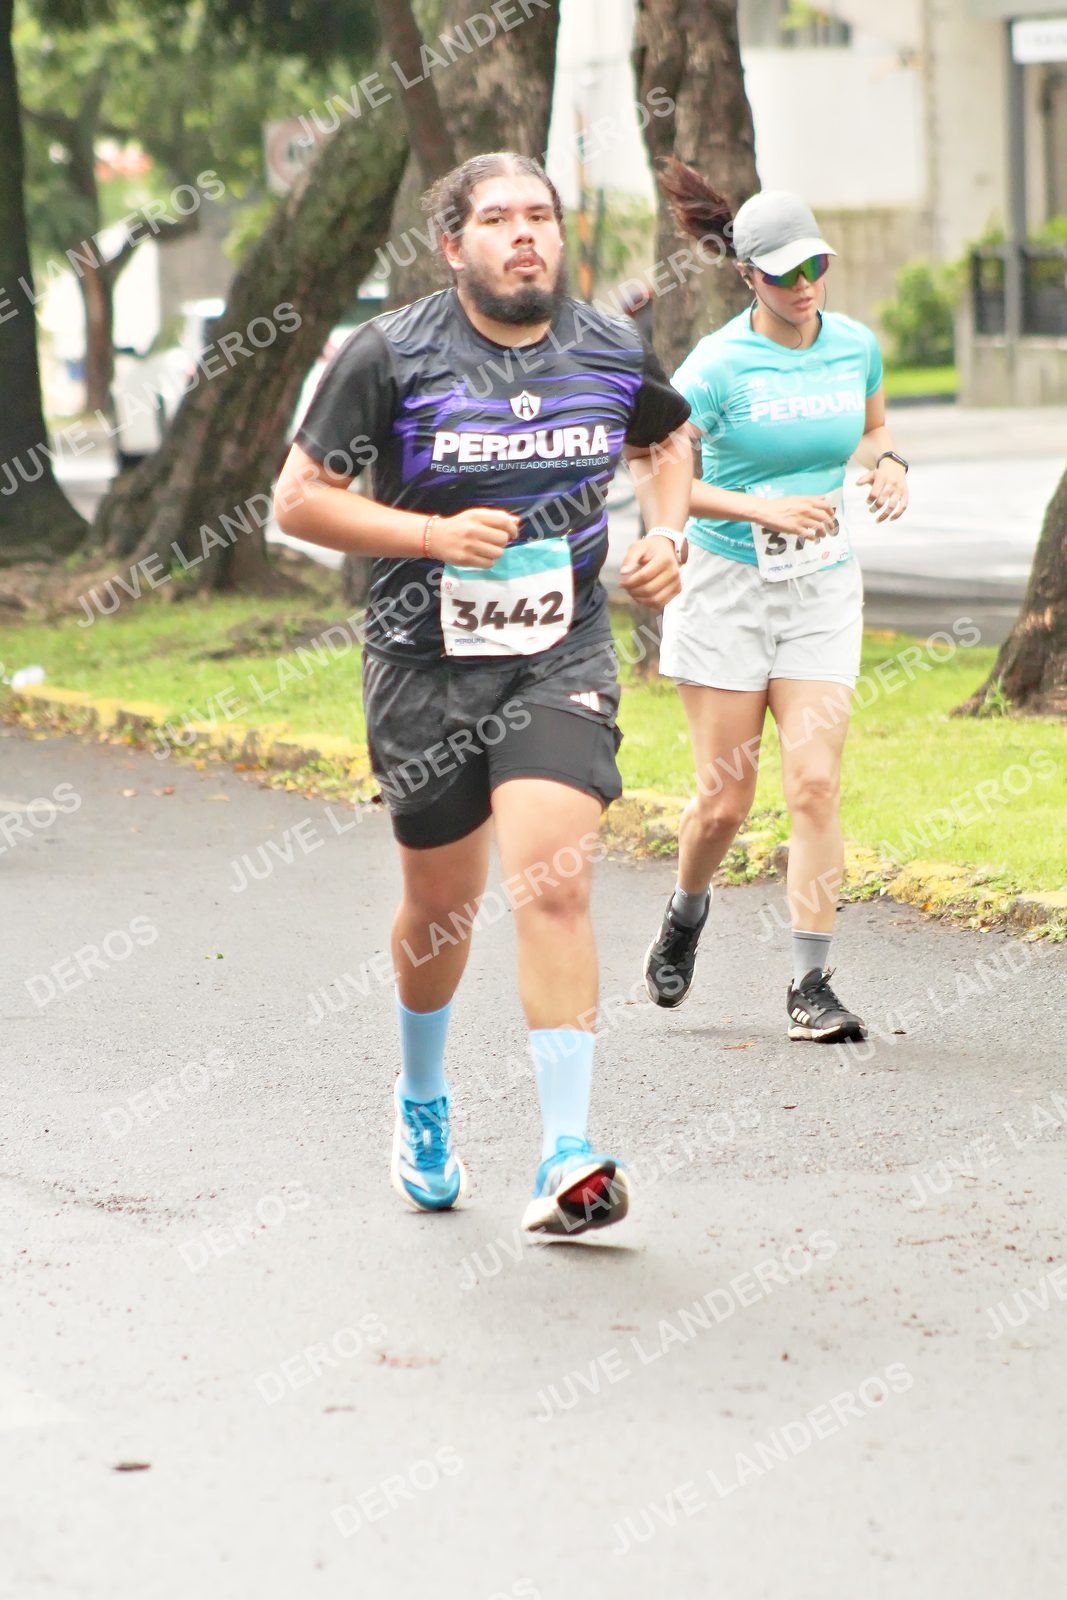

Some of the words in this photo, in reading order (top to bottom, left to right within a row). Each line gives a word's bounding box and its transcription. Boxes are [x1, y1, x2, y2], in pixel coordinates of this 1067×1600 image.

[432, 425, 609, 463] PERDURA
[430, 463, 456, 473] PEGA
[459, 463, 488, 473] PISOS
[452, 591, 564, 633] 3442
